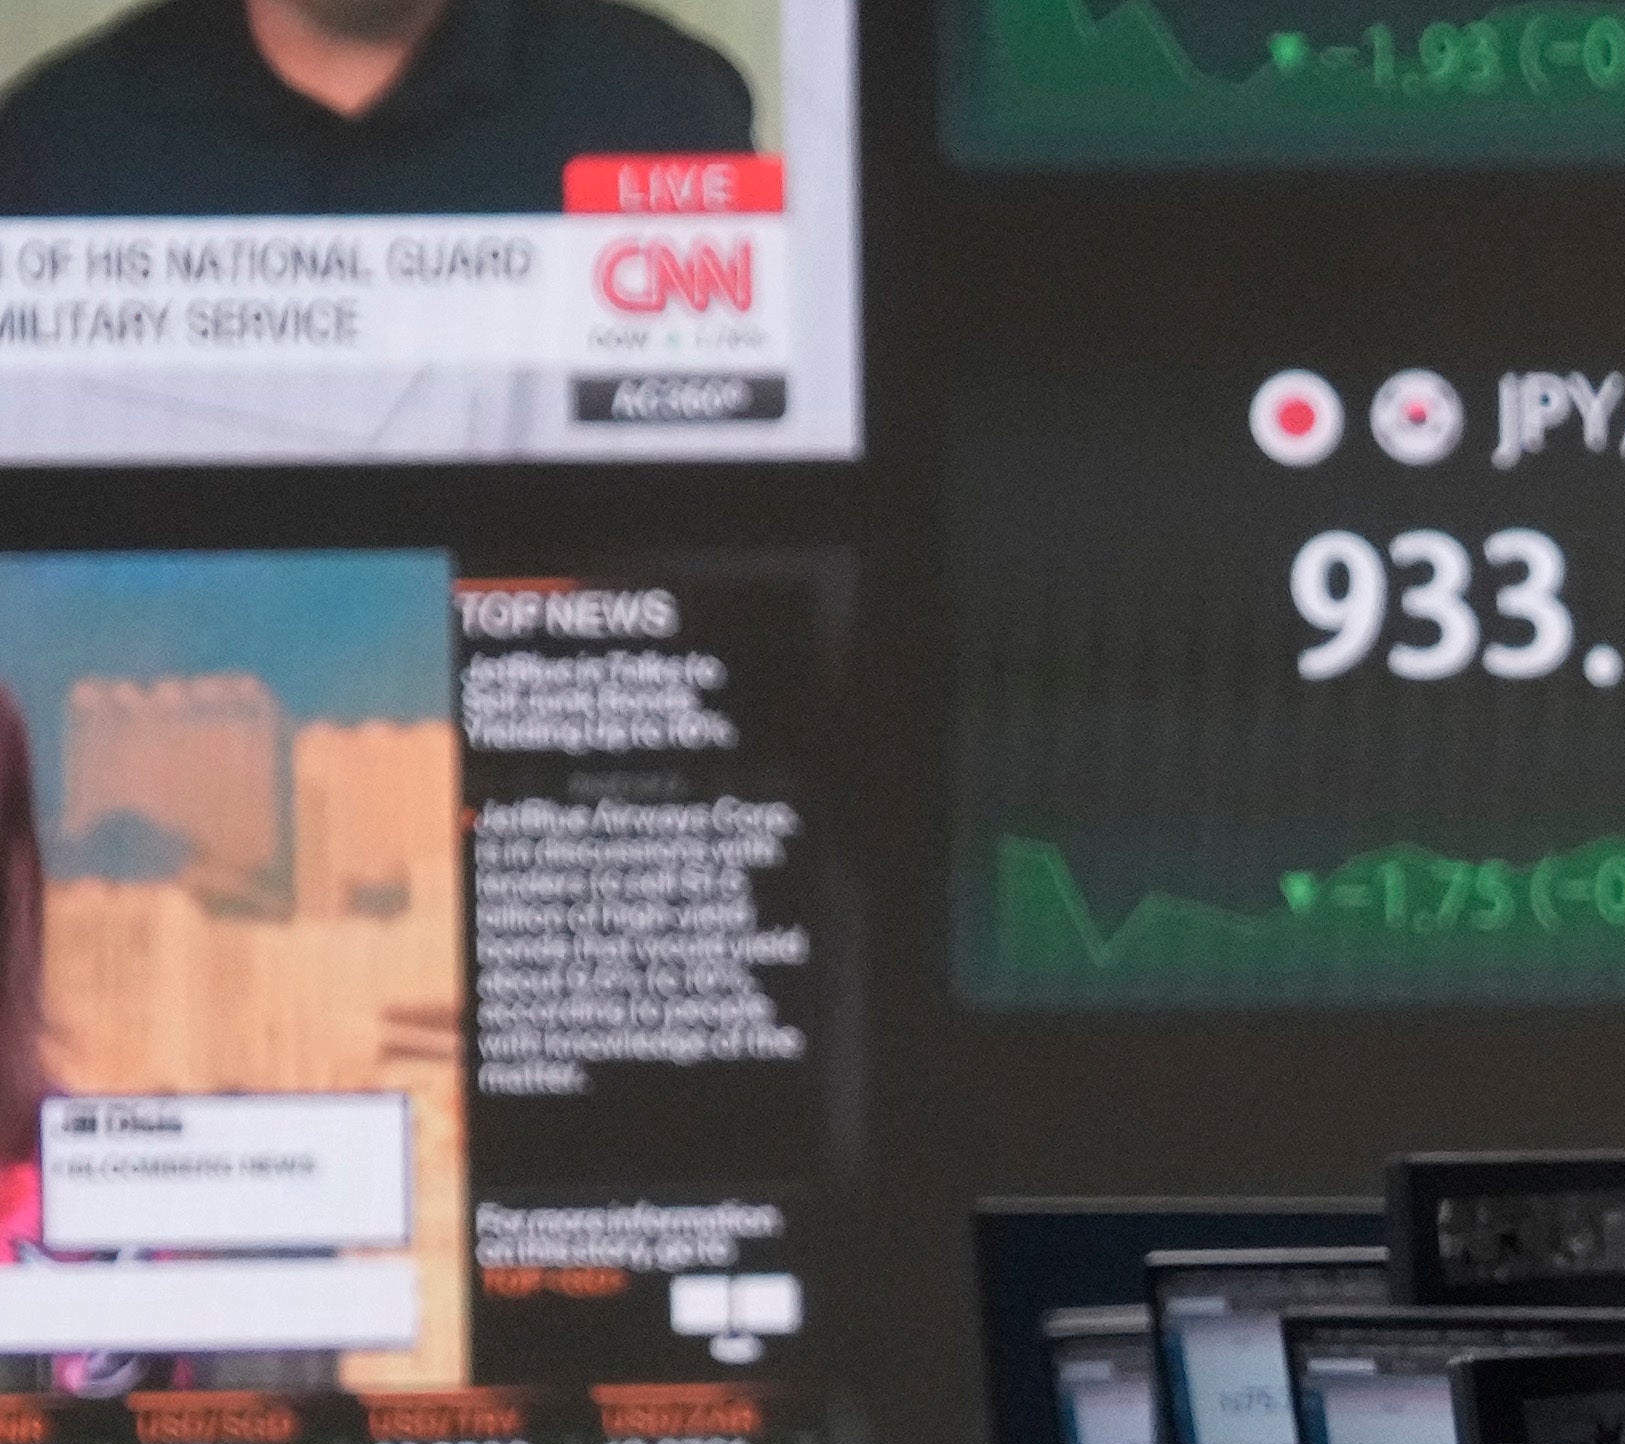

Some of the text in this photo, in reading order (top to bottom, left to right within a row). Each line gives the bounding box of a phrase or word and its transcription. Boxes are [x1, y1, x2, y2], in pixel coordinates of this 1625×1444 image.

[618, 163, 736, 214] LIVE
[86, 237, 152, 289] HIS
[164, 236, 372, 289] NATIONAL
[386, 235, 536, 287] GUARD
[592, 235, 756, 317] CNN
[185, 298, 362, 348] SERVICE
[459, 589, 681, 639] TOP NEWS
